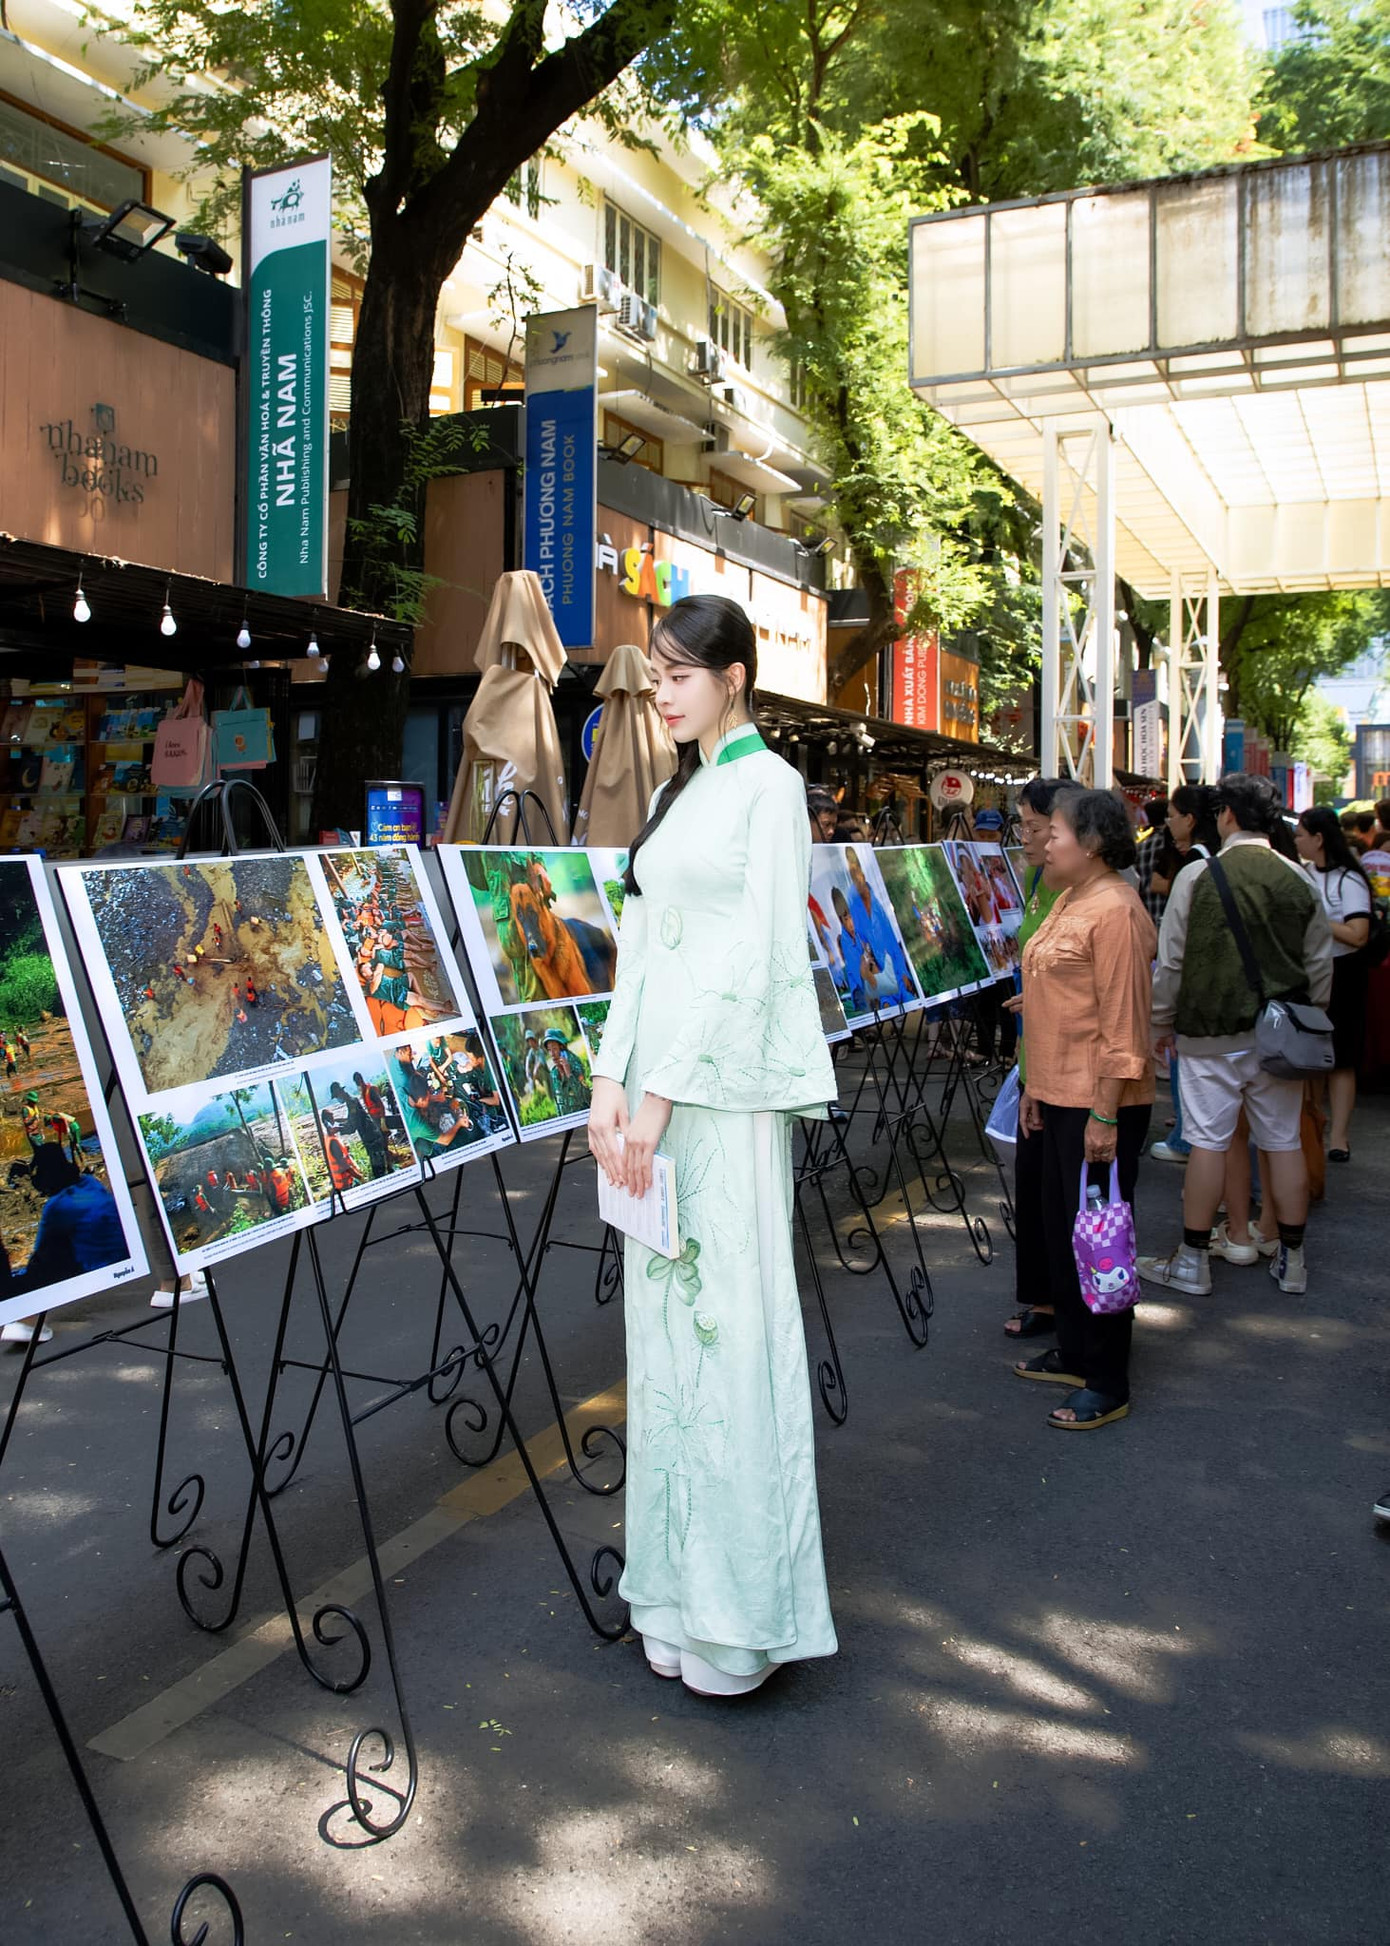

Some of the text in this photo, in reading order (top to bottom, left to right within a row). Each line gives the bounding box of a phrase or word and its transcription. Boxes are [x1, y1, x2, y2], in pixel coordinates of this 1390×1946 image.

[261, 289, 272, 336] THÔNG
[261, 389, 271, 399] &
[272, 353, 297, 507] NHÃ NAM
[300, 291, 314, 564] Nha Nam Publishing and Communications JSC.
[541, 420, 556, 468] NAM
[259, 433, 270, 460] VĂN
[257, 502, 269, 520] CỔ
[562, 434, 575, 605] PHUONG NAM BOOK
[259, 523, 268, 539] TY
[257, 541, 268, 579] CÔNG
[619, 542, 690, 606] SÁCH
[917, 669, 928, 706] DONG
[904, 696, 915, 725] NHÀ
[917, 707, 927, 725] KIM
